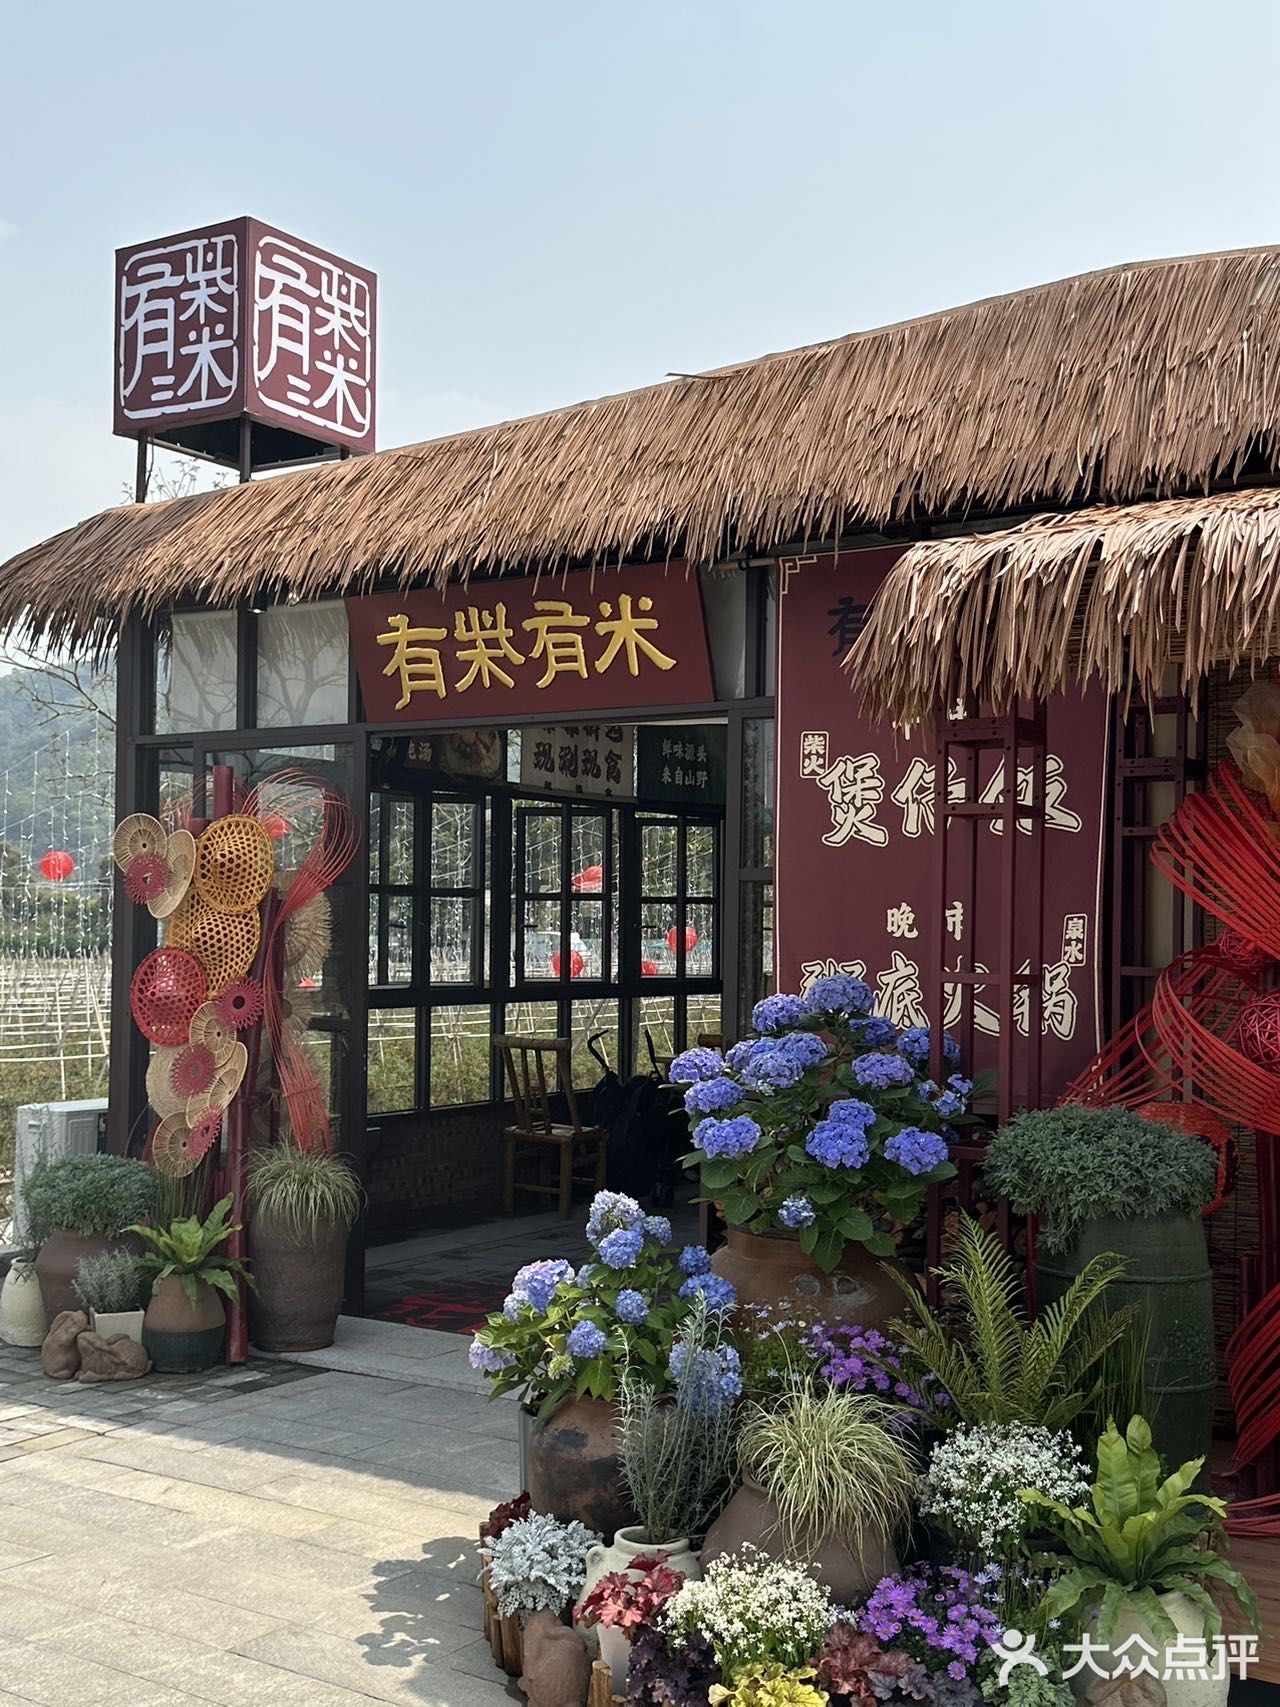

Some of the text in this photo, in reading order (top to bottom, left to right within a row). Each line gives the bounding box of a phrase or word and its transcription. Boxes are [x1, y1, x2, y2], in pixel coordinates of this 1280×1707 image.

[376, 592, 678, 712] 有柴有米
[803, 734, 826, 777] 柴火
[1064, 918, 1084, 963] 泉水
